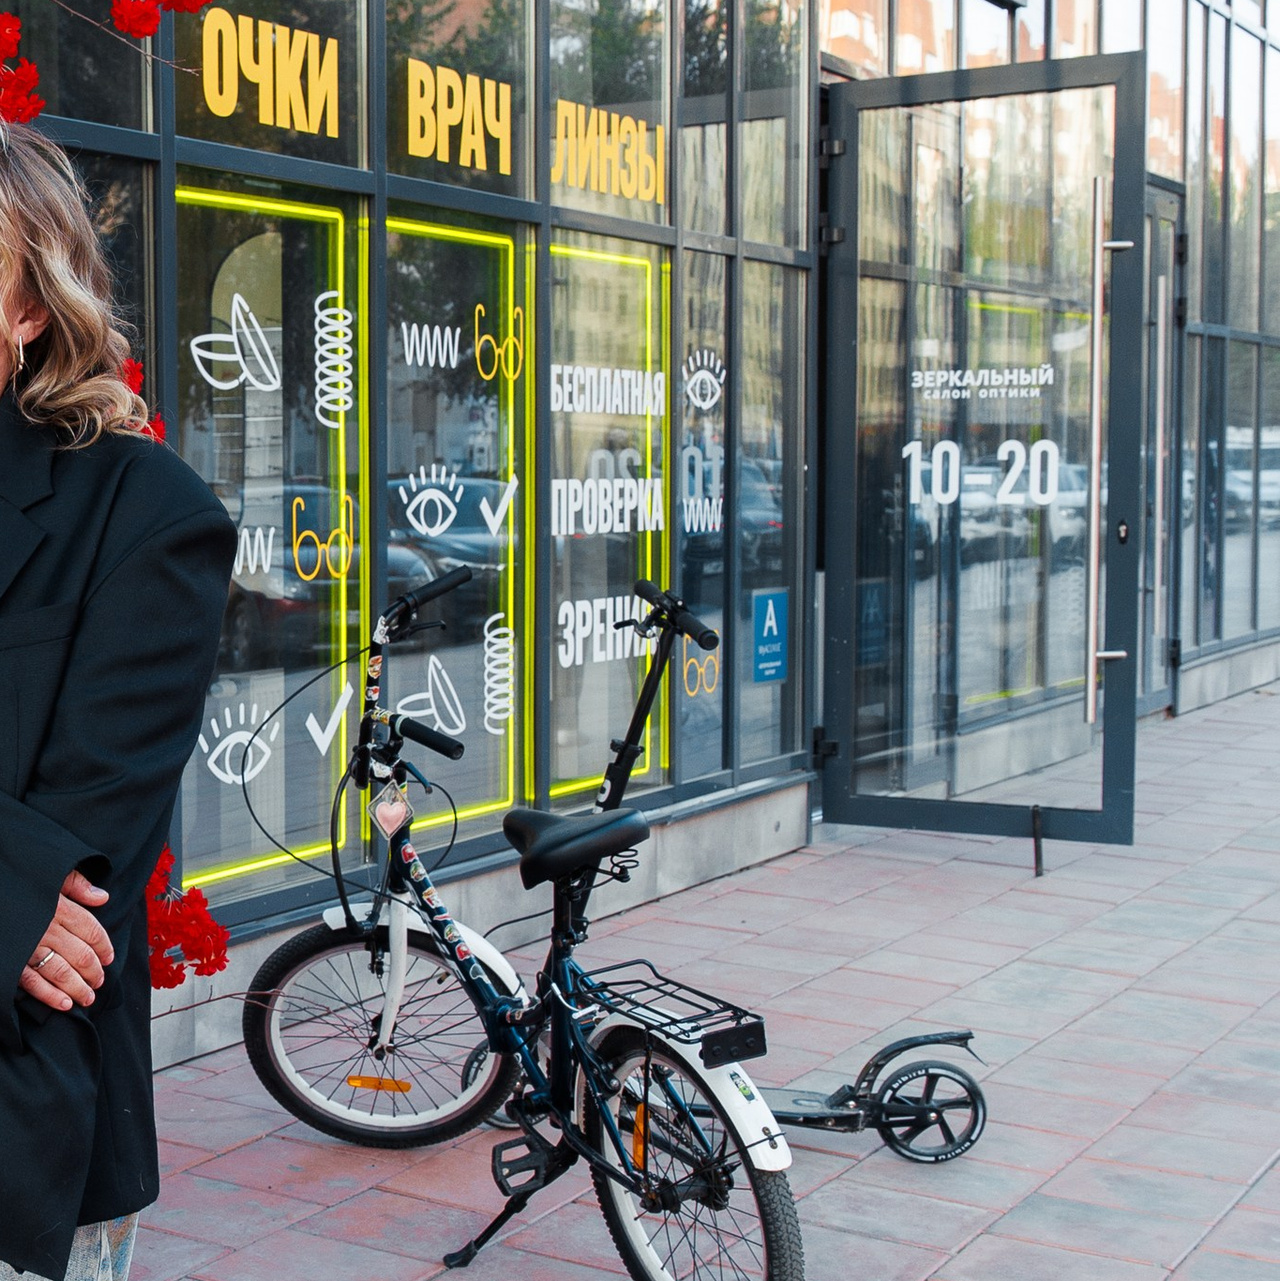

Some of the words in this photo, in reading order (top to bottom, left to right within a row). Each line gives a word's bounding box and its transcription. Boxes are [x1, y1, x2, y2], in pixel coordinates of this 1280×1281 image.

[202, 6, 340, 138] ОЧКИ
[407, 57, 512, 176] ВРАЧ
[550, 98, 666, 205] ЛИНЗЫ
[550, 364, 665, 416] БЕСПЛАТНАЯ
[911, 363, 1054, 388] ЗЕРКАЛЬНЫЙ
[923, 388, 971, 400] салон
[978, 387, 1041, 399] оптики
[551, 477, 665, 536] ПРОВЕРКА
